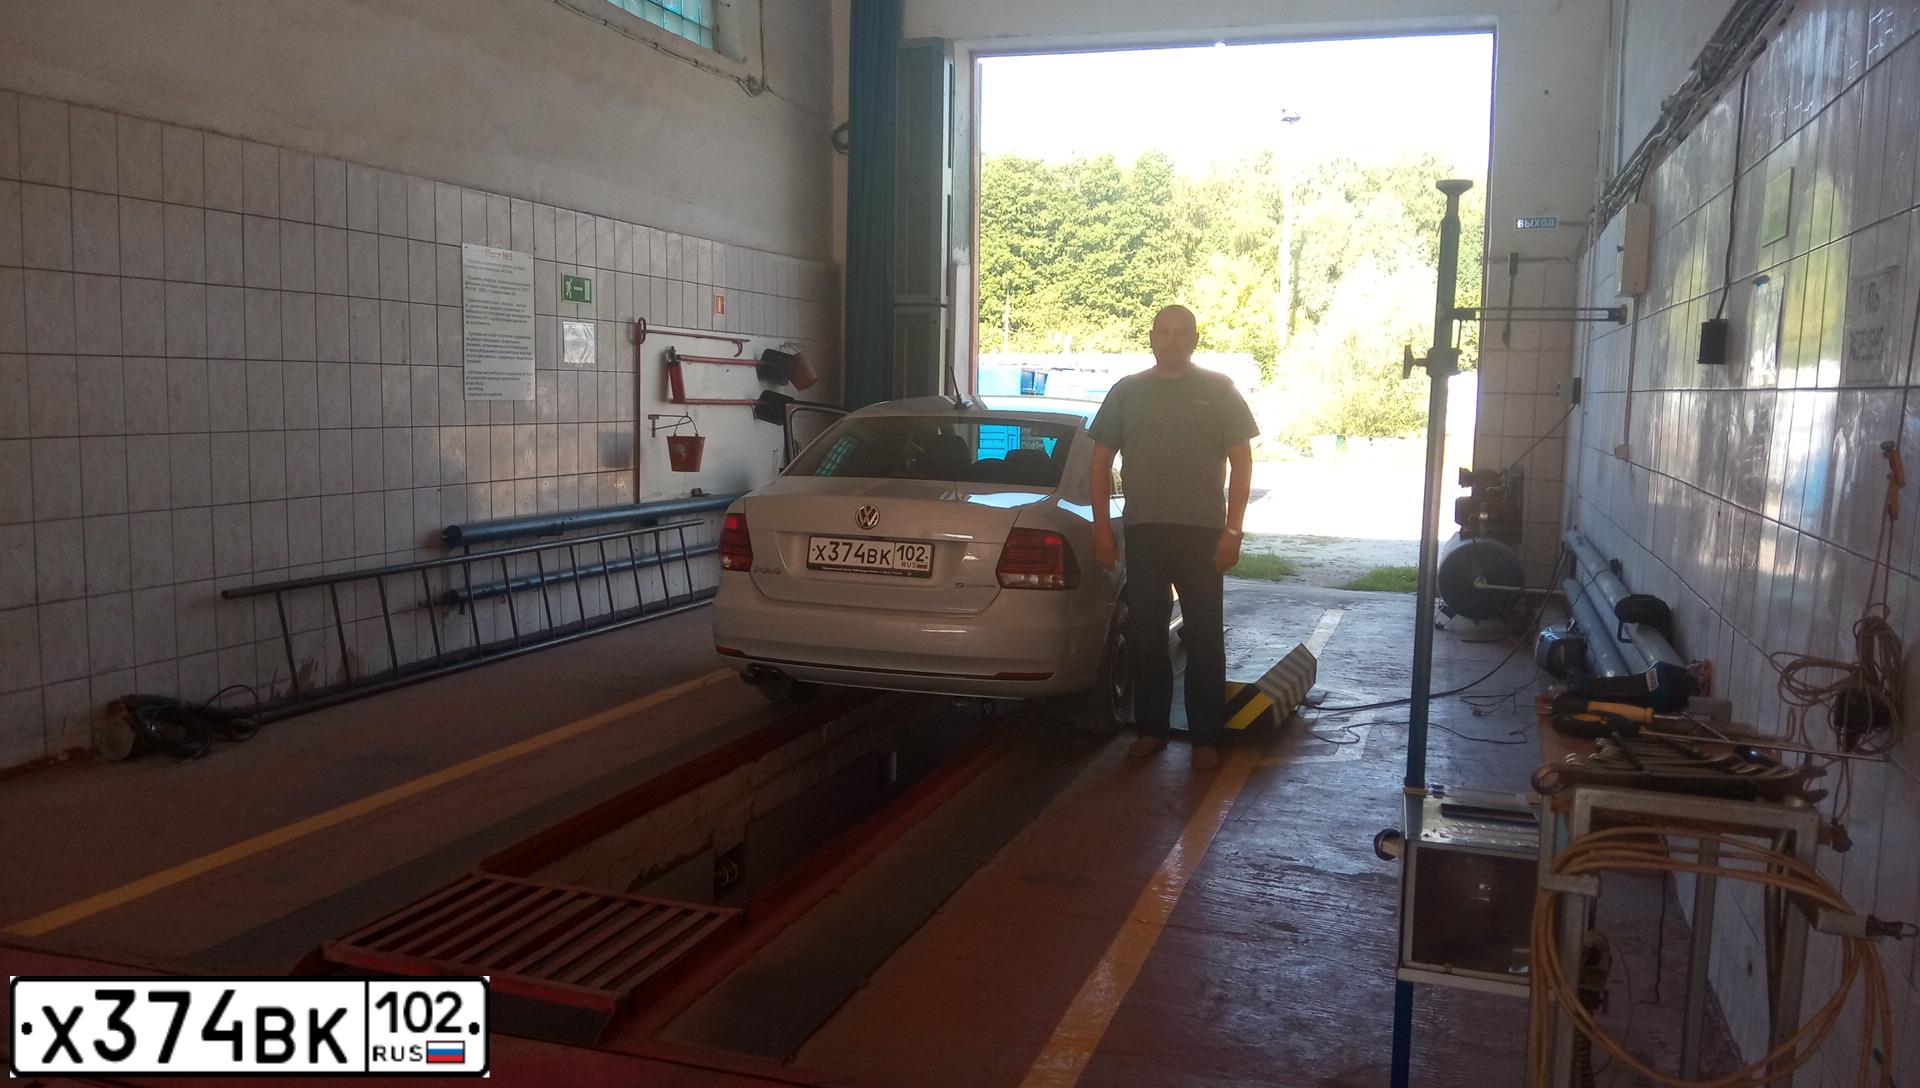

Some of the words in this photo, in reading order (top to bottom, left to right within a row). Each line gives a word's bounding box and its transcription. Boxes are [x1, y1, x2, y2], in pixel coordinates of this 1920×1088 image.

[1517, 218, 1555, 229] ВЫХОД
[896, 545, 926, 562] 102
[901, 560, 918, 569] RUS
